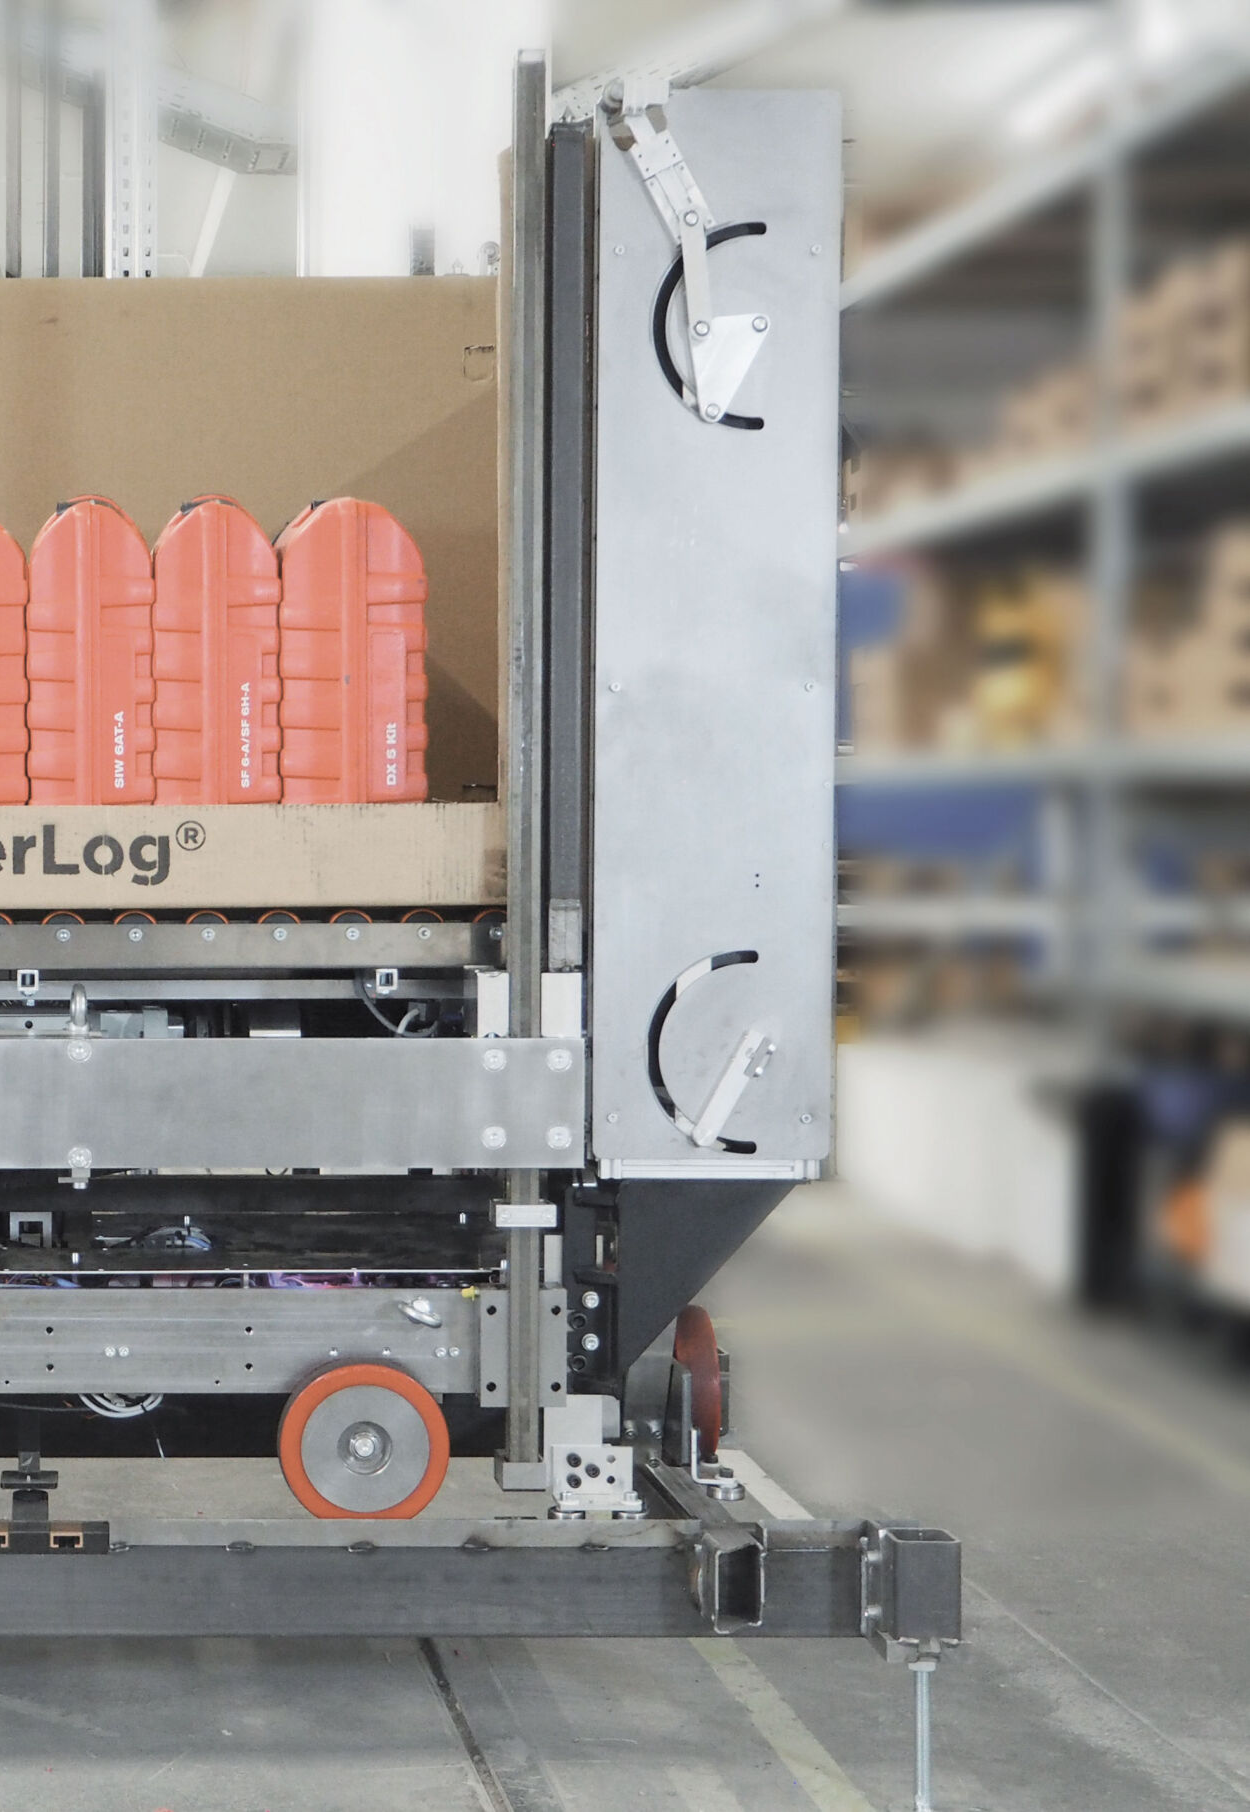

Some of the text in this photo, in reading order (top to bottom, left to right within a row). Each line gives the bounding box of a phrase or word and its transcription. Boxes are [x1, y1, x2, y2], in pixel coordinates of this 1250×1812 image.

[114, 711, 124, 789] SIW 6AT-A
[241, 682, 250, 788] SF 6-A/SF 6H-A
[386, 723, 396, 744] Kit
[386, 764, 396, 786] DX
